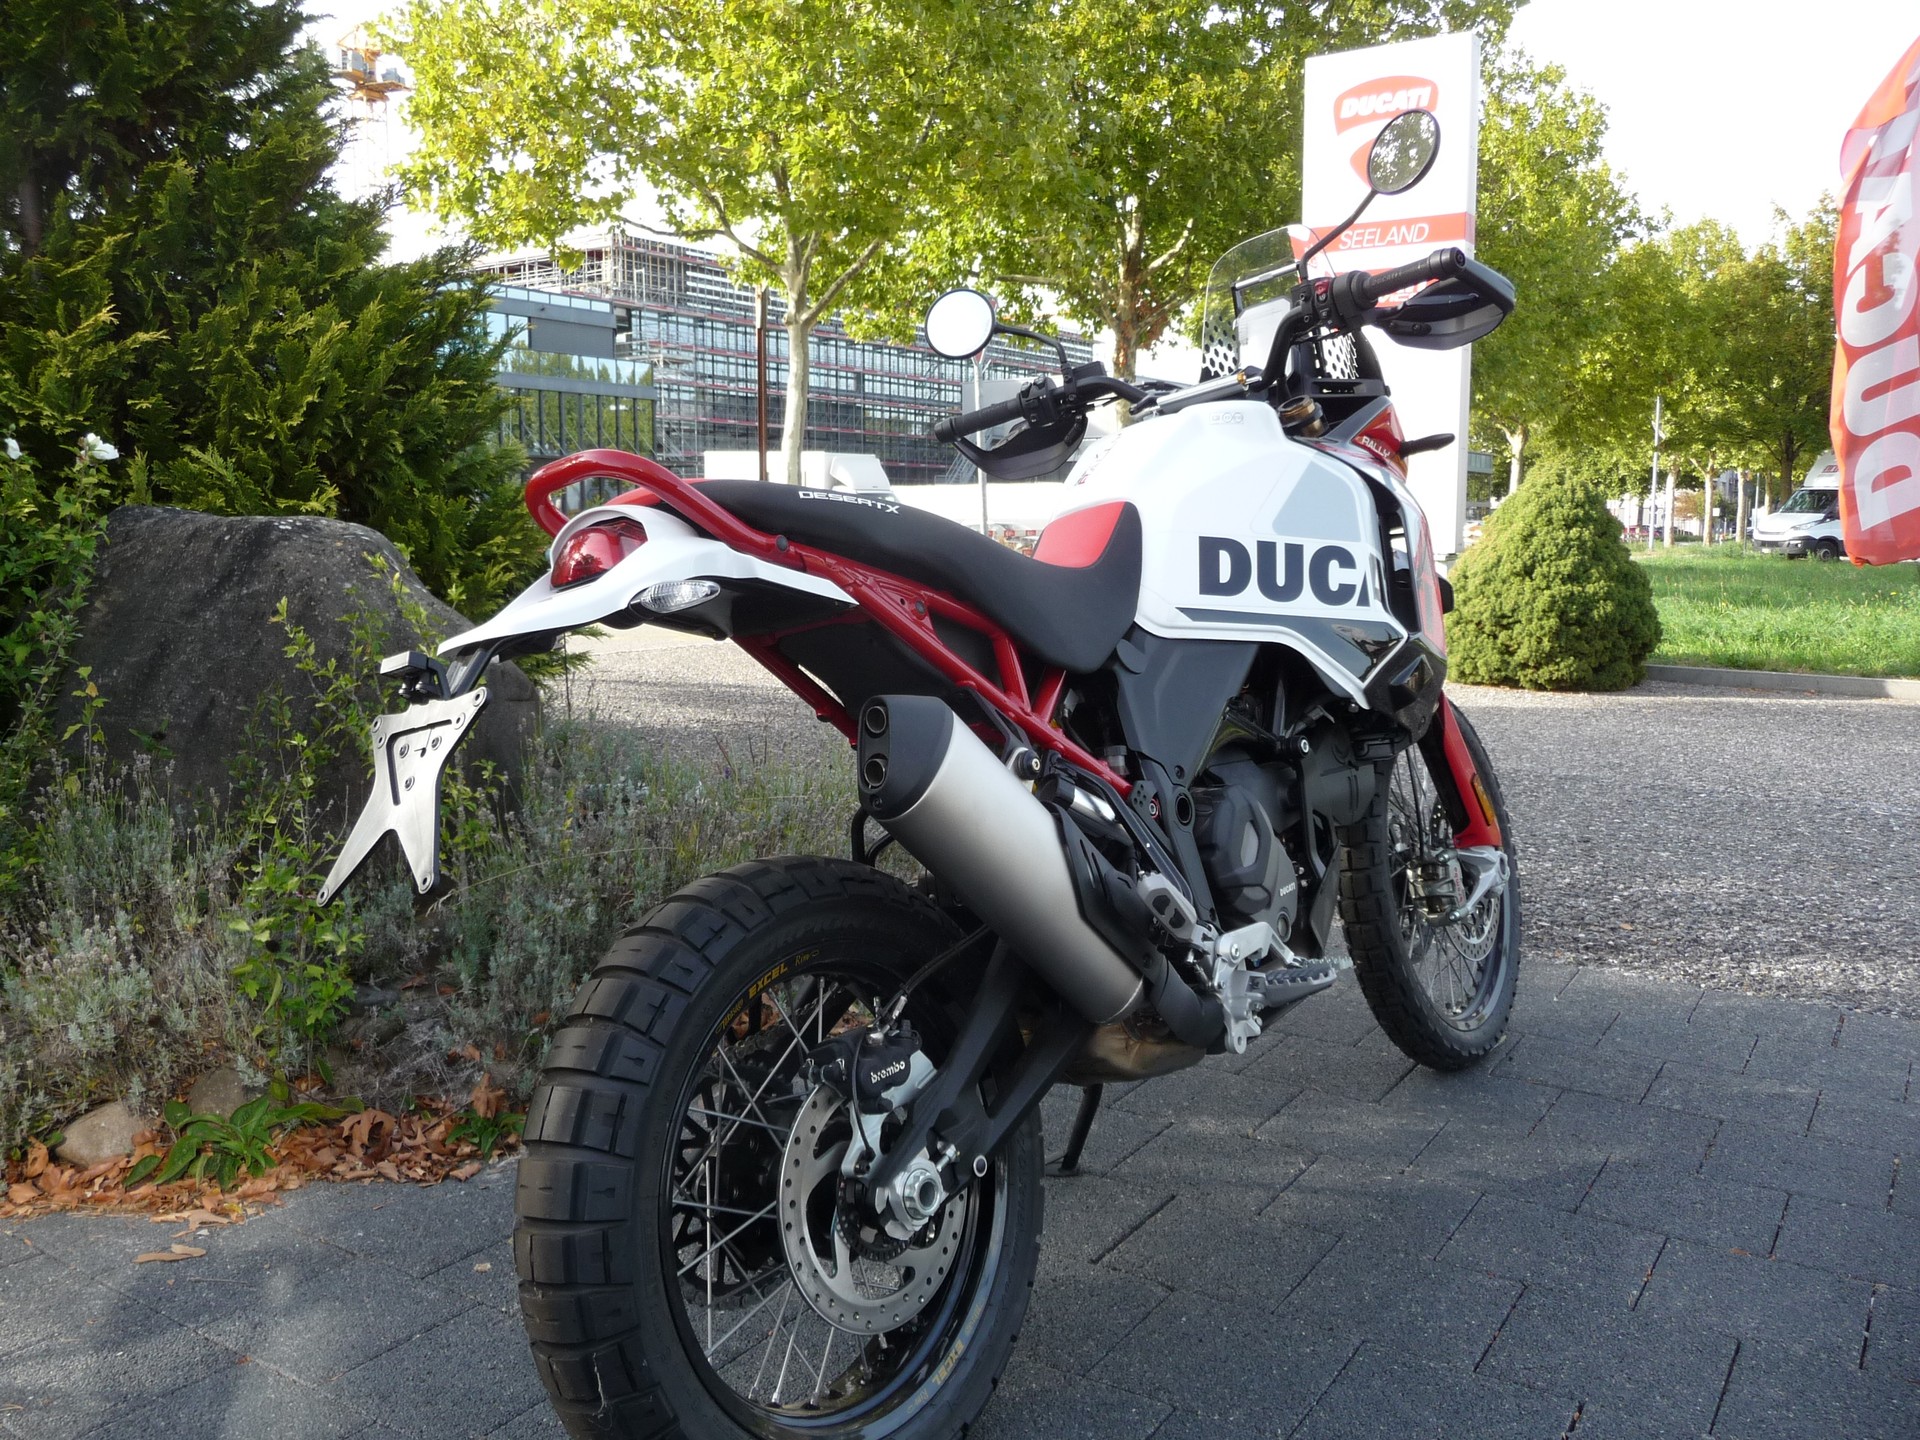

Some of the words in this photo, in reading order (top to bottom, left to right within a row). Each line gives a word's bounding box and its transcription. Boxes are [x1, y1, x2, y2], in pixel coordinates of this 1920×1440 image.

[1339, 86, 1431, 120] DUCATI
[1338, 223, 1430, 250] SEELAND
[1361, 435, 1391, 459] RALLY
[1279, 882, 1297, 897] DUCATI
[748, 962, 789, 999] EXCEL
[870, 1060, 906, 1084] brembo
[931, 1339, 965, 1386] EXCEL
